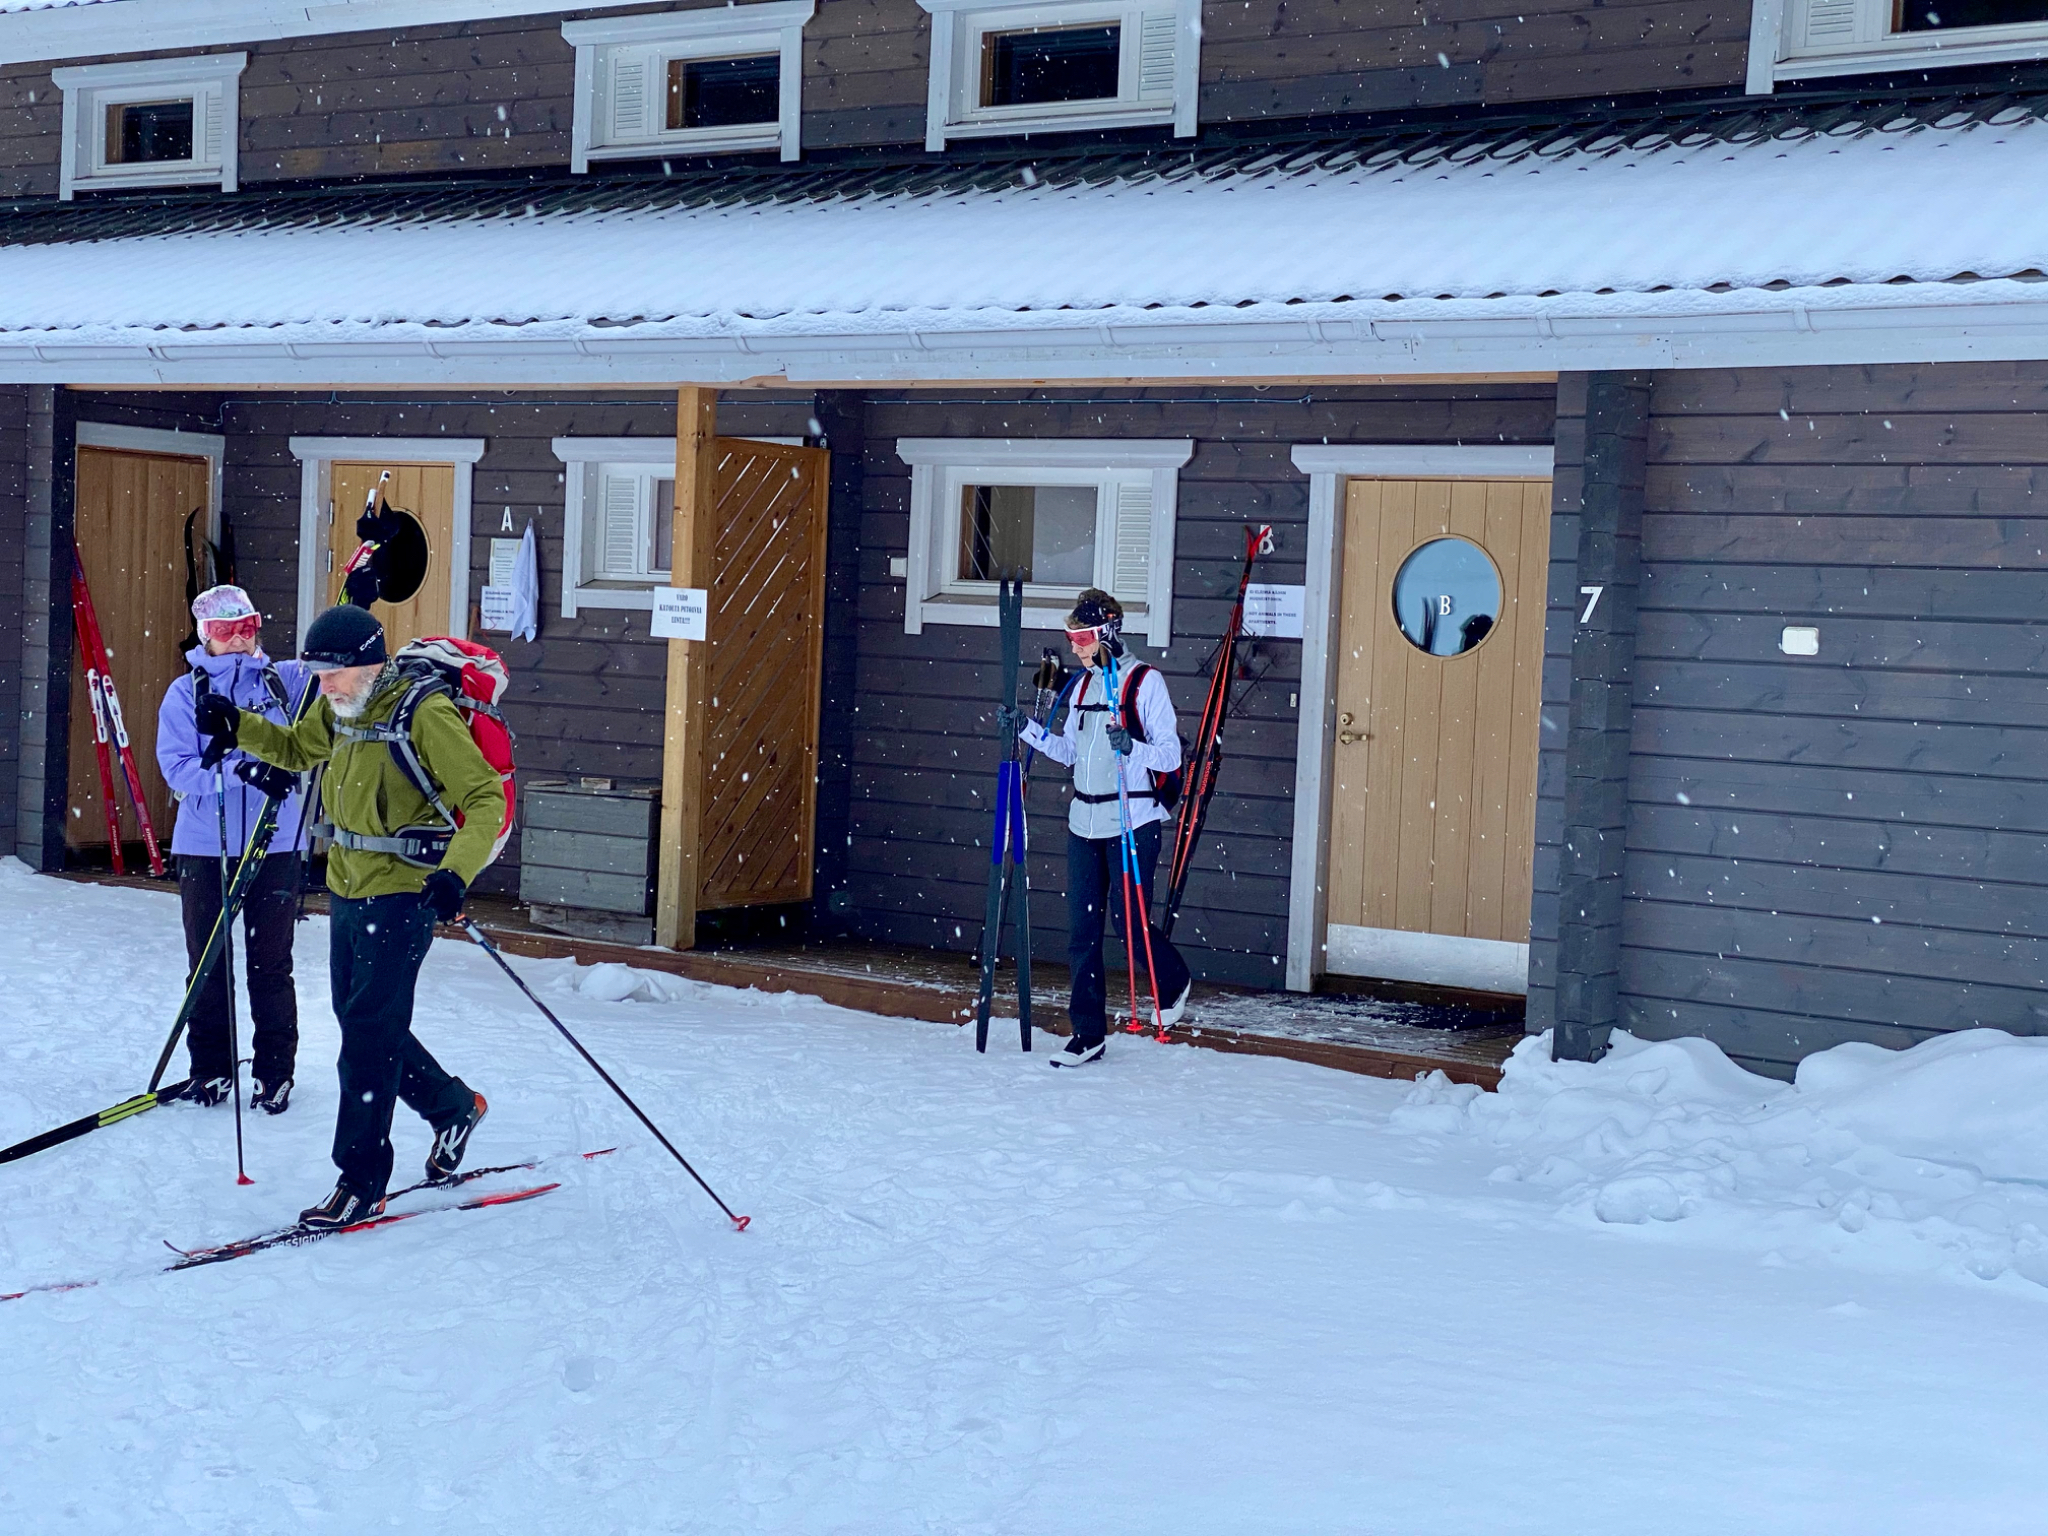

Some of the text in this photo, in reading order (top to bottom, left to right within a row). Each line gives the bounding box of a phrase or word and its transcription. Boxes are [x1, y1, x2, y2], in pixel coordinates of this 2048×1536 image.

[501, 506, 513, 531] A
[1259, 524, 1272, 554] B
[1439, 595, 1450, 615] B
[1580, 586, 1604, 623] 7
[1183, 761, 1196, 796] ROSSIGNOL
[1199, 761, 1212, 796] ROSSIGNOL
